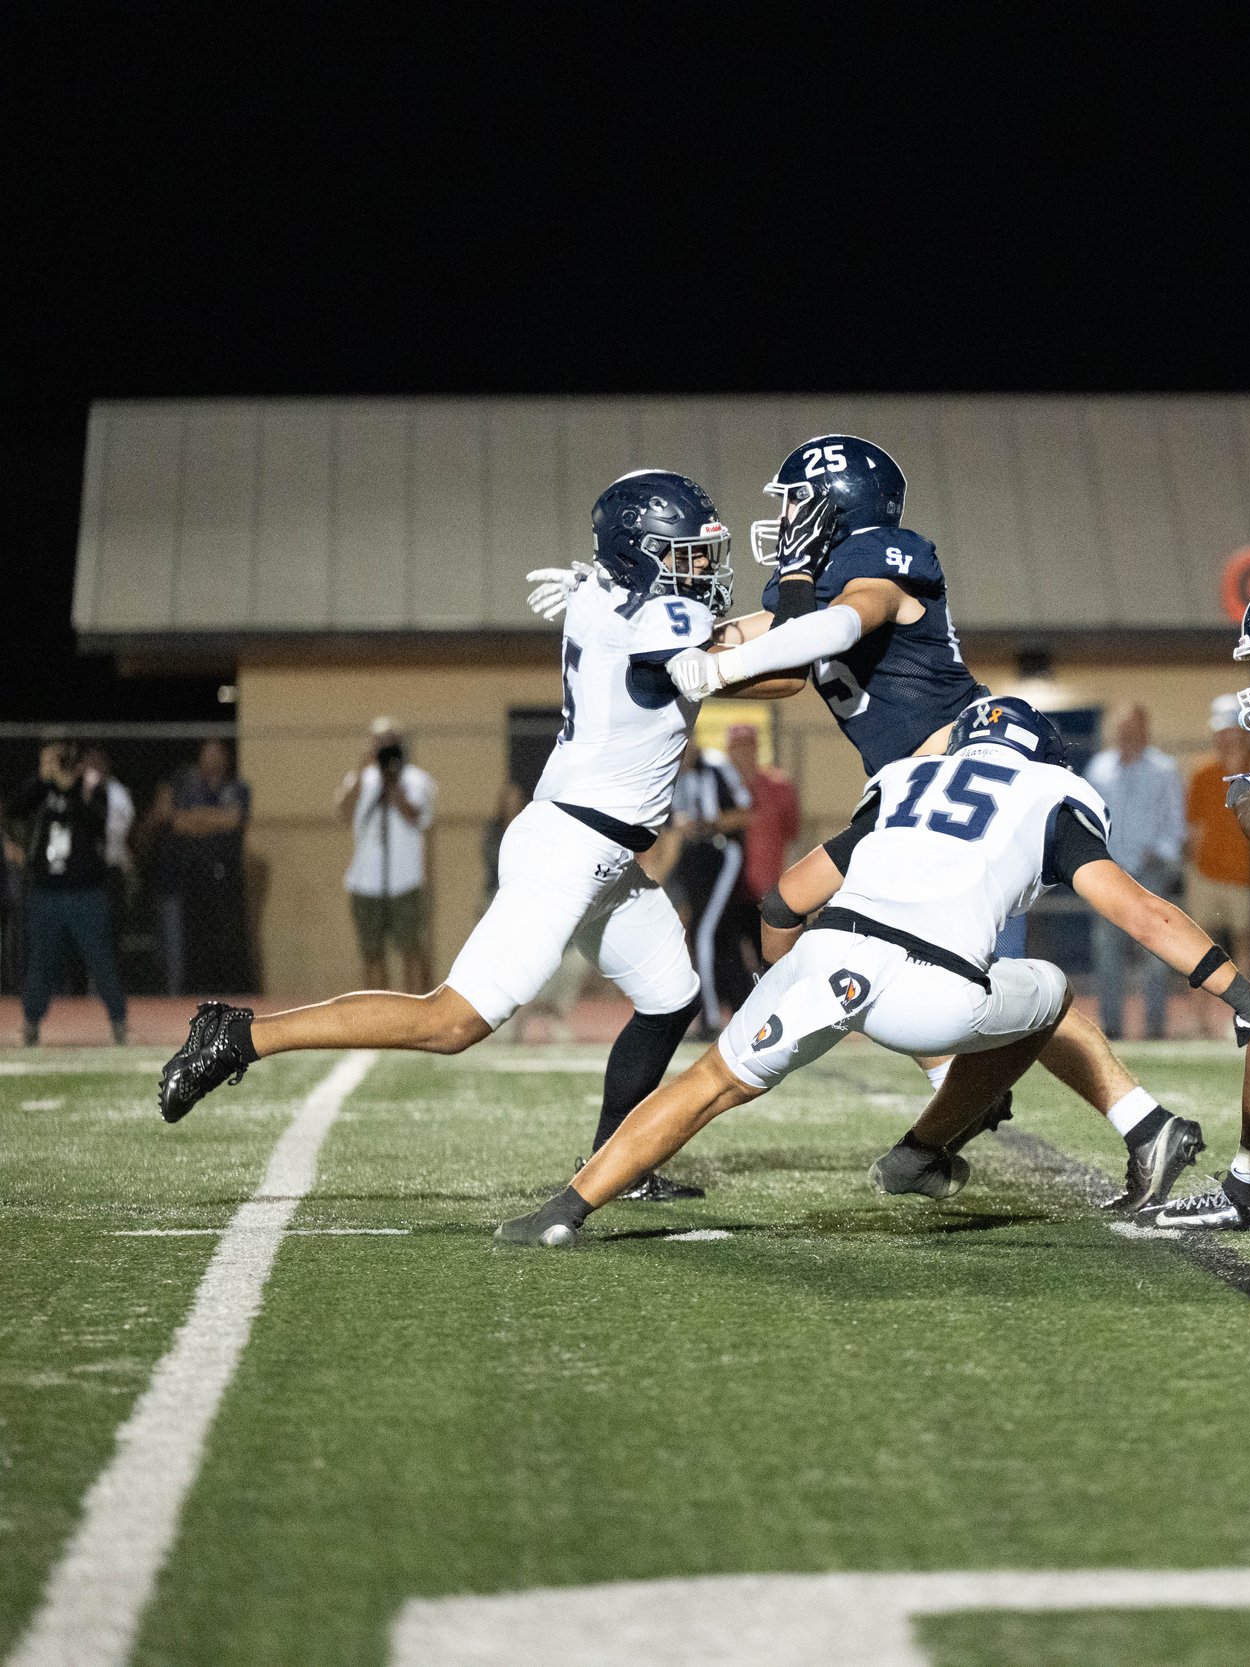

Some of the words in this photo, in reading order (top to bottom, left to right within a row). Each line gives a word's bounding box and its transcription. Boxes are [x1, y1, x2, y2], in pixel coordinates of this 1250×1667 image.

[803, 445, 847, 477] 25
[885, 547, 913, 574] SV
[665, 601, 692, 637] 5
[885, 758, 1021, 843] 15
